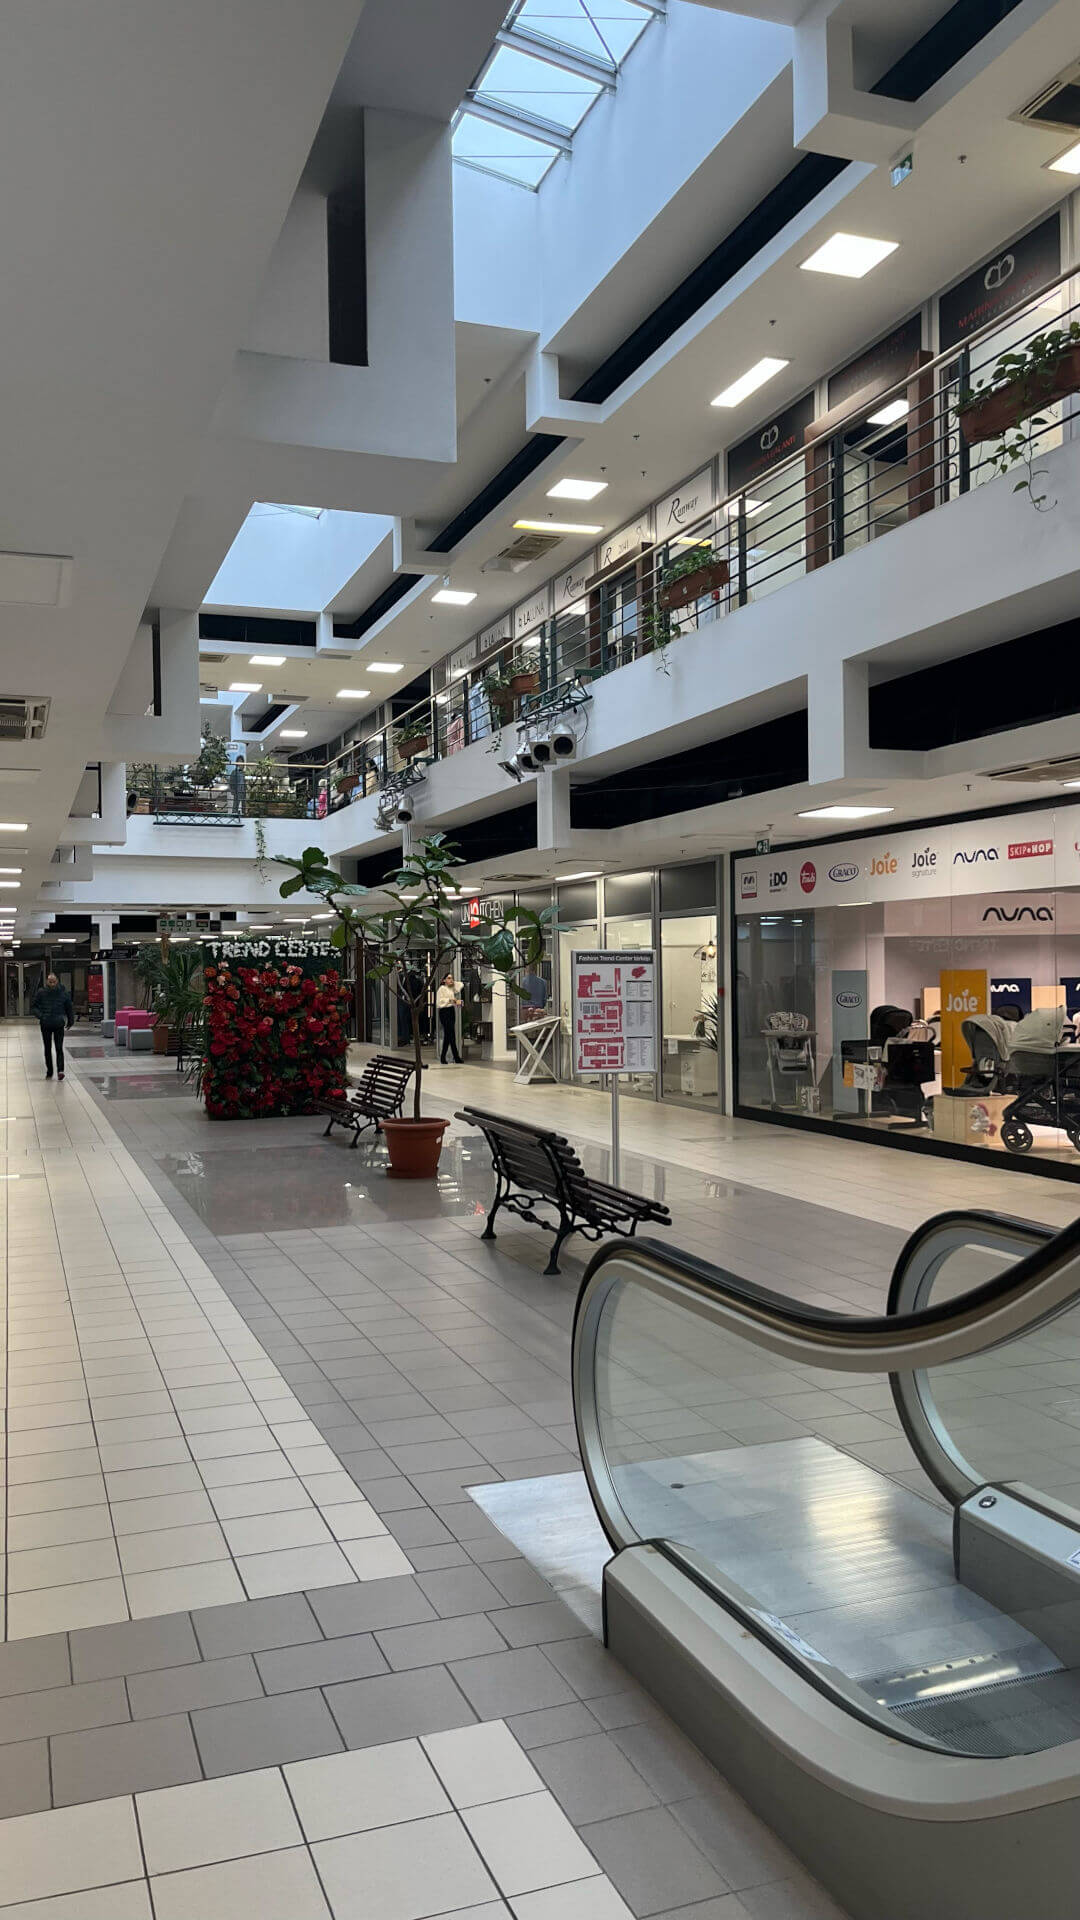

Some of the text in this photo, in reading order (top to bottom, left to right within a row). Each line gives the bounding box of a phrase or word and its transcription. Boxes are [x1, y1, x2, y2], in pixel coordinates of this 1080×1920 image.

[870, 851, 898, 876] Joie
[912, 847, 937, 868] Joie
[953, 848, 999, 864] nuna
[769, 871, 788, 887] iDO
[832, 867, 856, 878] GRACO
[982, 907, 1053, 921] nuna
[205, 941, 271, 959] TREND
[946, 989, 978, 1013] Joie
